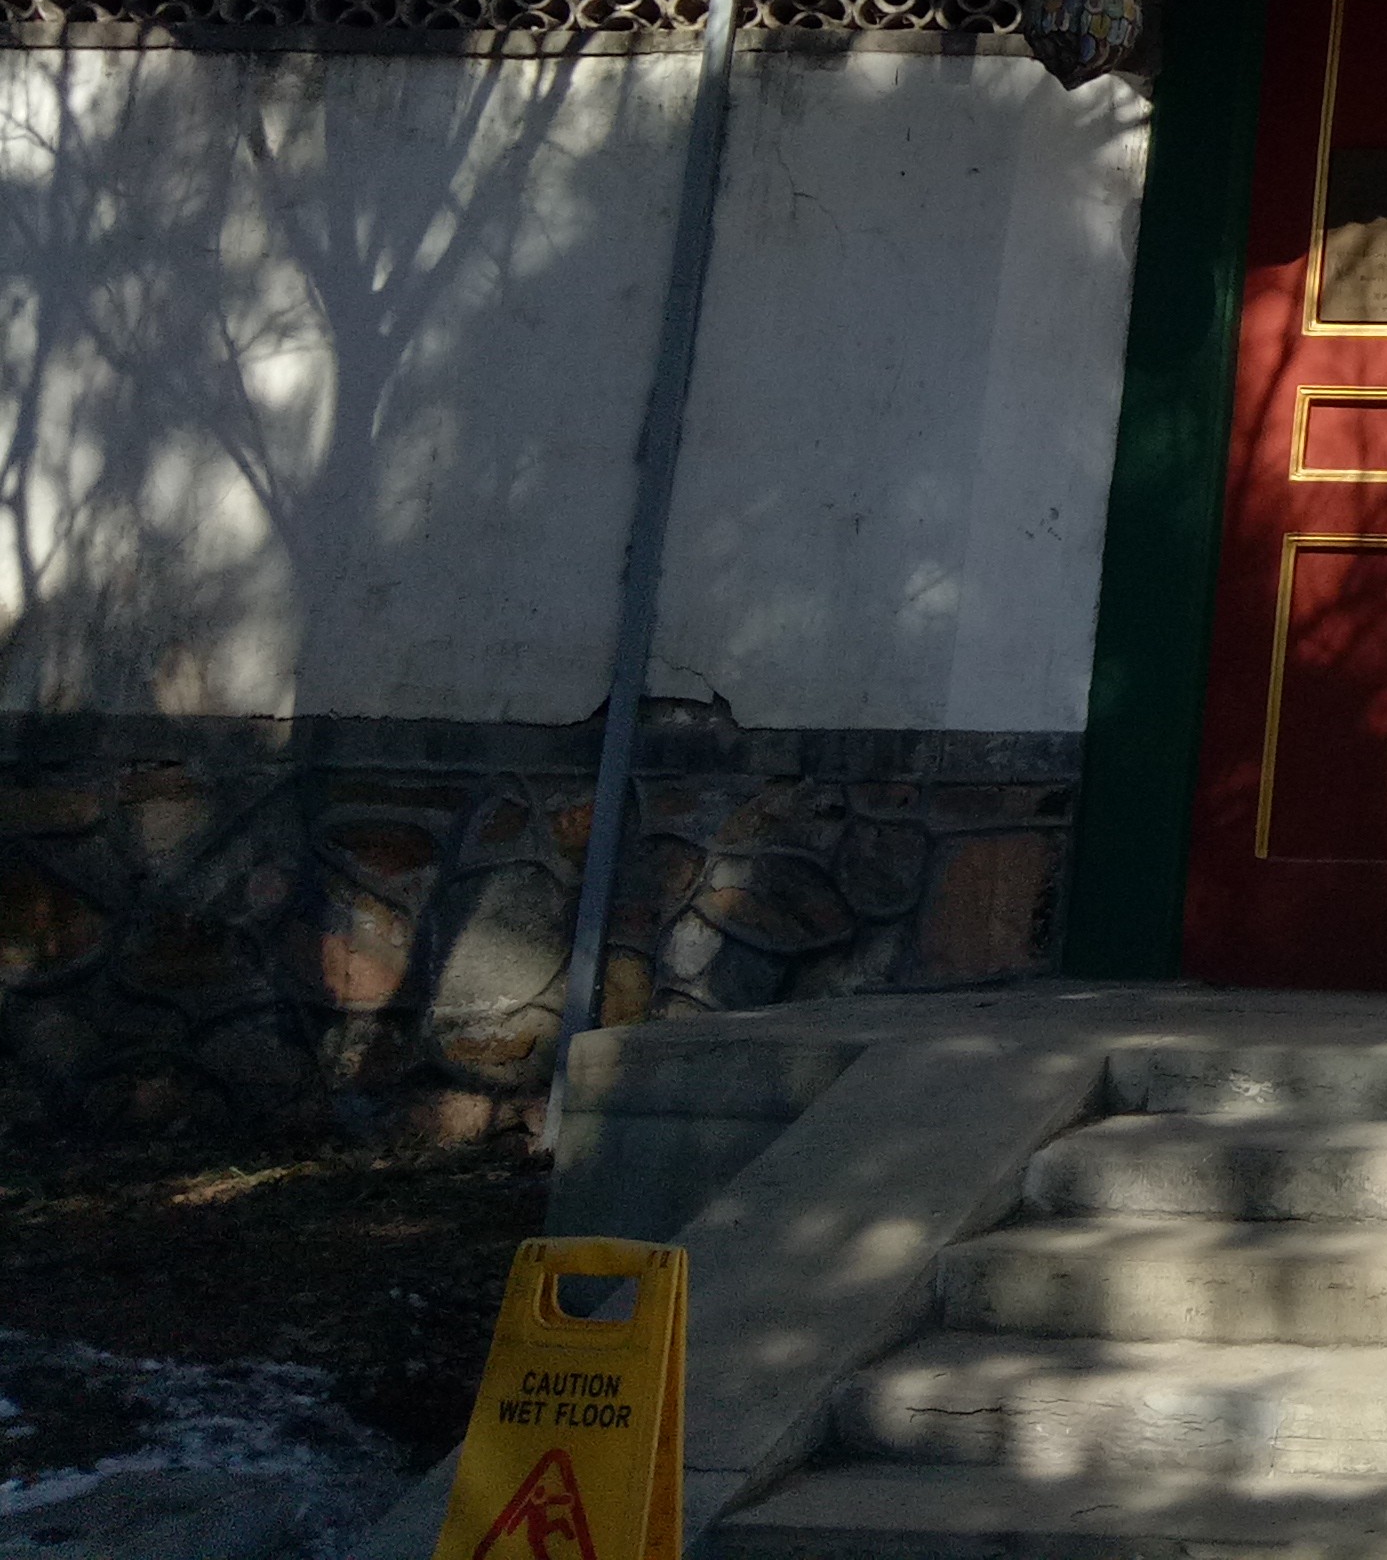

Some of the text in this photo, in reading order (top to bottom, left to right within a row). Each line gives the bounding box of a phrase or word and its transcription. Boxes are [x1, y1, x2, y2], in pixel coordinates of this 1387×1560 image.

[522, 1371, 622, 1397] CAUTION
[500, 1400, 632, 1428] WET FLOOR
